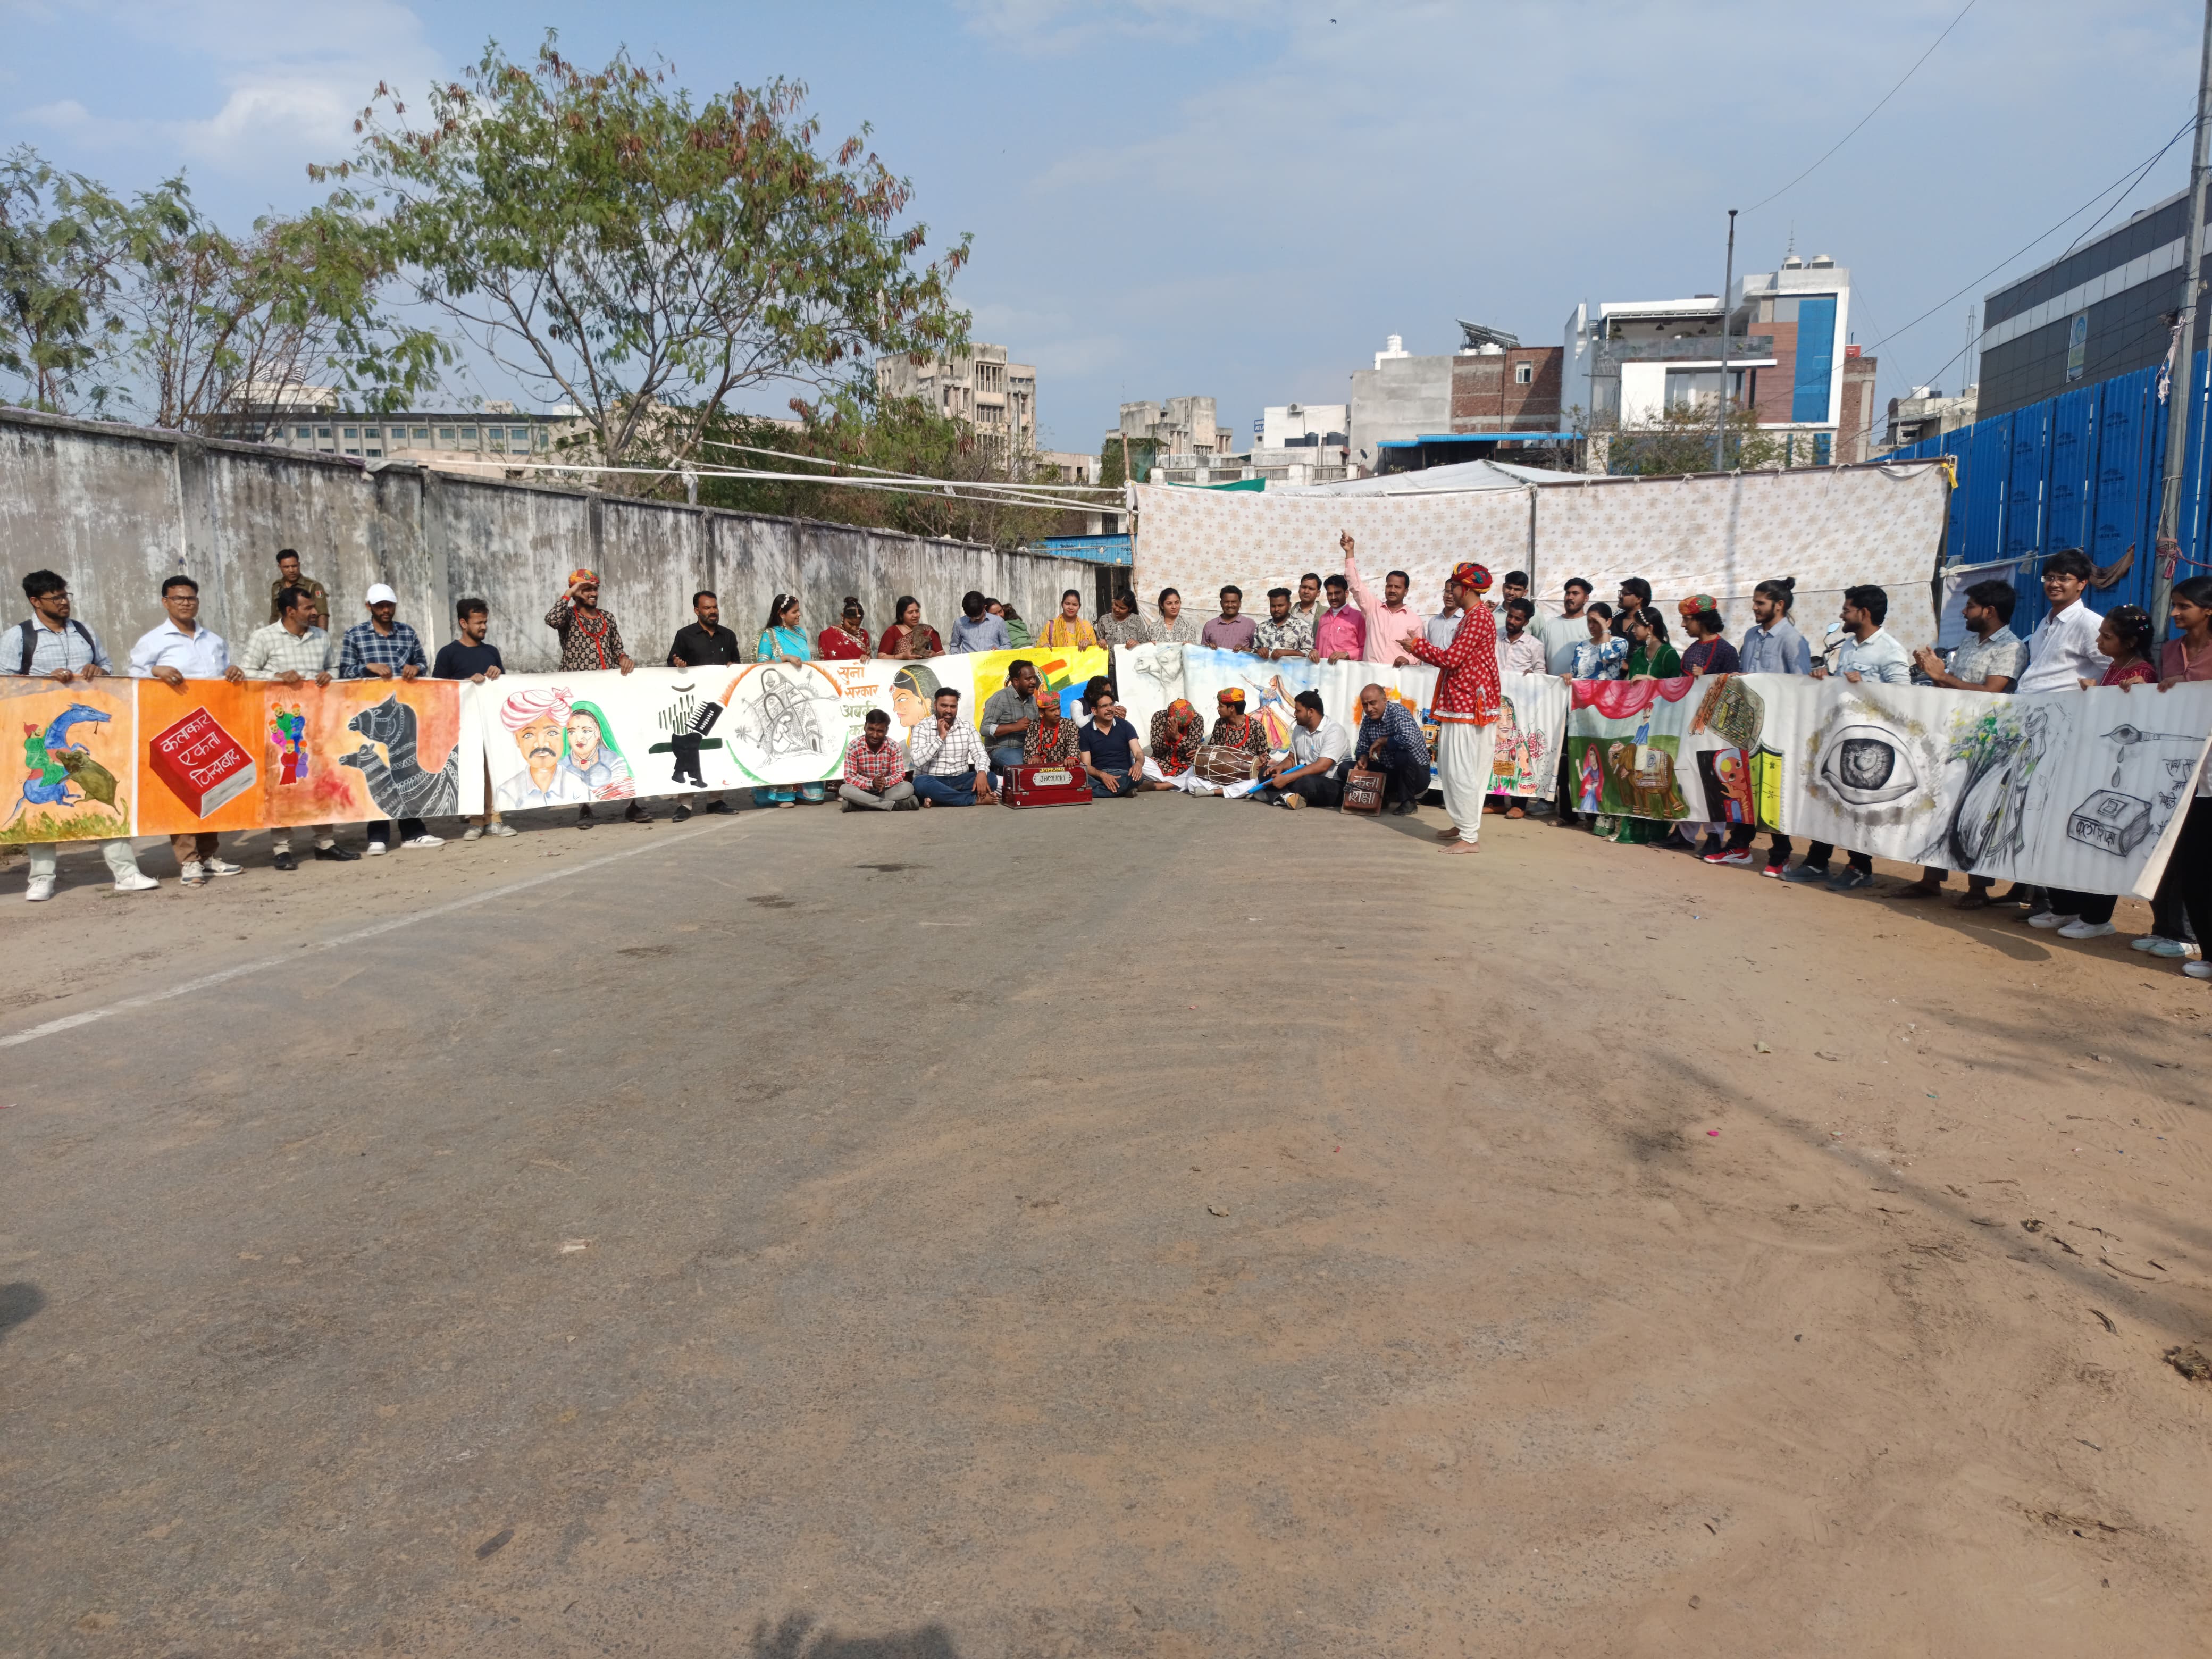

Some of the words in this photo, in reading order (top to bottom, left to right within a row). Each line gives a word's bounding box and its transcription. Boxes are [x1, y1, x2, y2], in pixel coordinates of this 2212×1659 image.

[837, 661, 865, 685] सुनो
[844, 684, 879, 700] सरकार
[160, 714, 211, 752] कलाकार
[178, 732, 221, 766] एकता
[1353, 776, 1379, 789] कला
[1348, 787, 1378, 805] शिक्षा
[2076, 818, 2099, 839] कला
